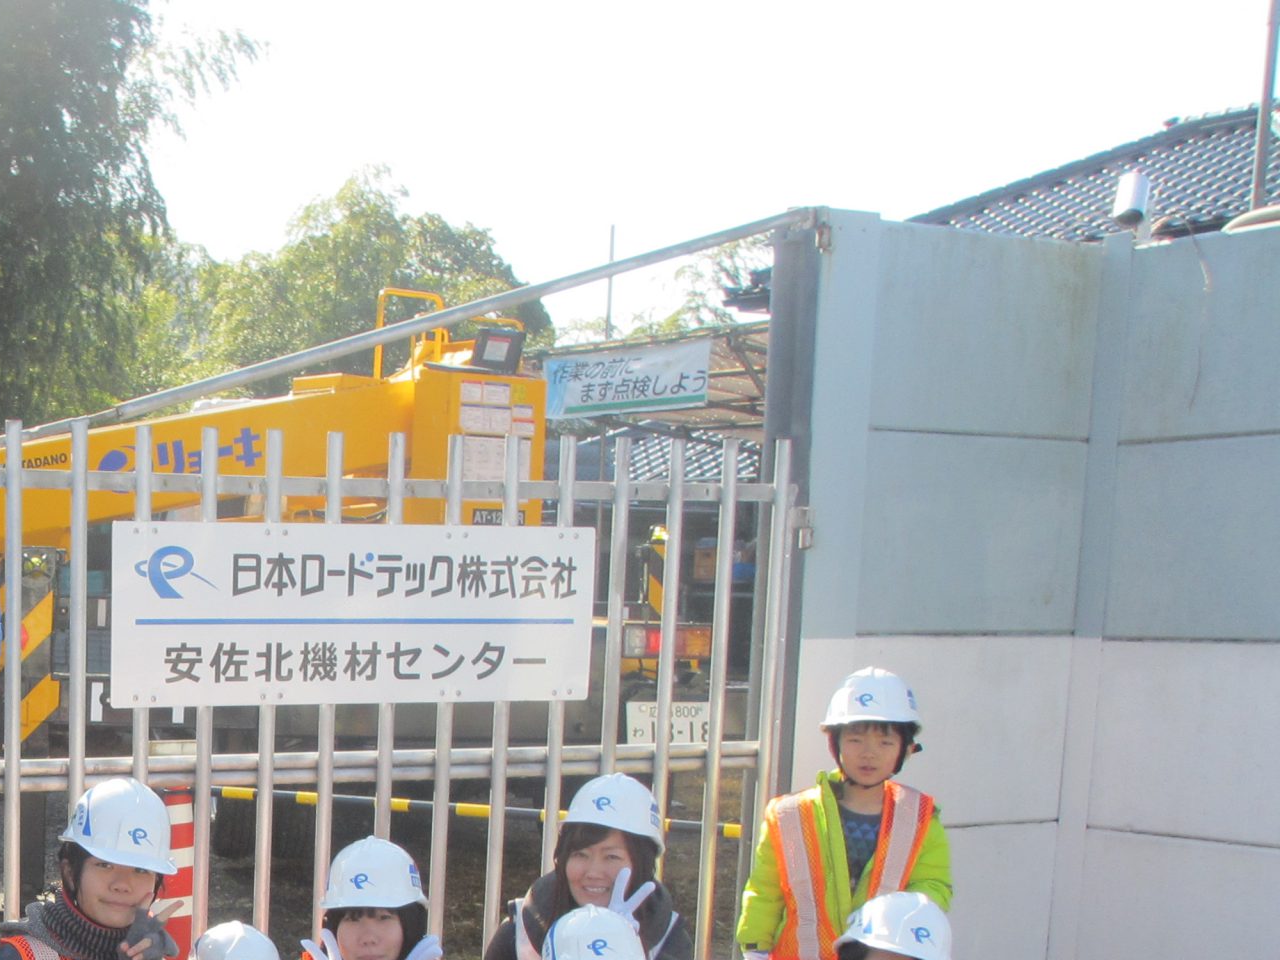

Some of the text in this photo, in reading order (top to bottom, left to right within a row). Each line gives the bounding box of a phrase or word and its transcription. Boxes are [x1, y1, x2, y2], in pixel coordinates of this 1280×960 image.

[553, 357, 642, 384] 作業の前に
[581, 370, 707, 403] まず点検しよう
[474, 510, 524, 525] AT-12R
[231, 552, 578, 600] 日本ロードテック株式会社
[164, 641, 547, 684] 安佐北機材センター
